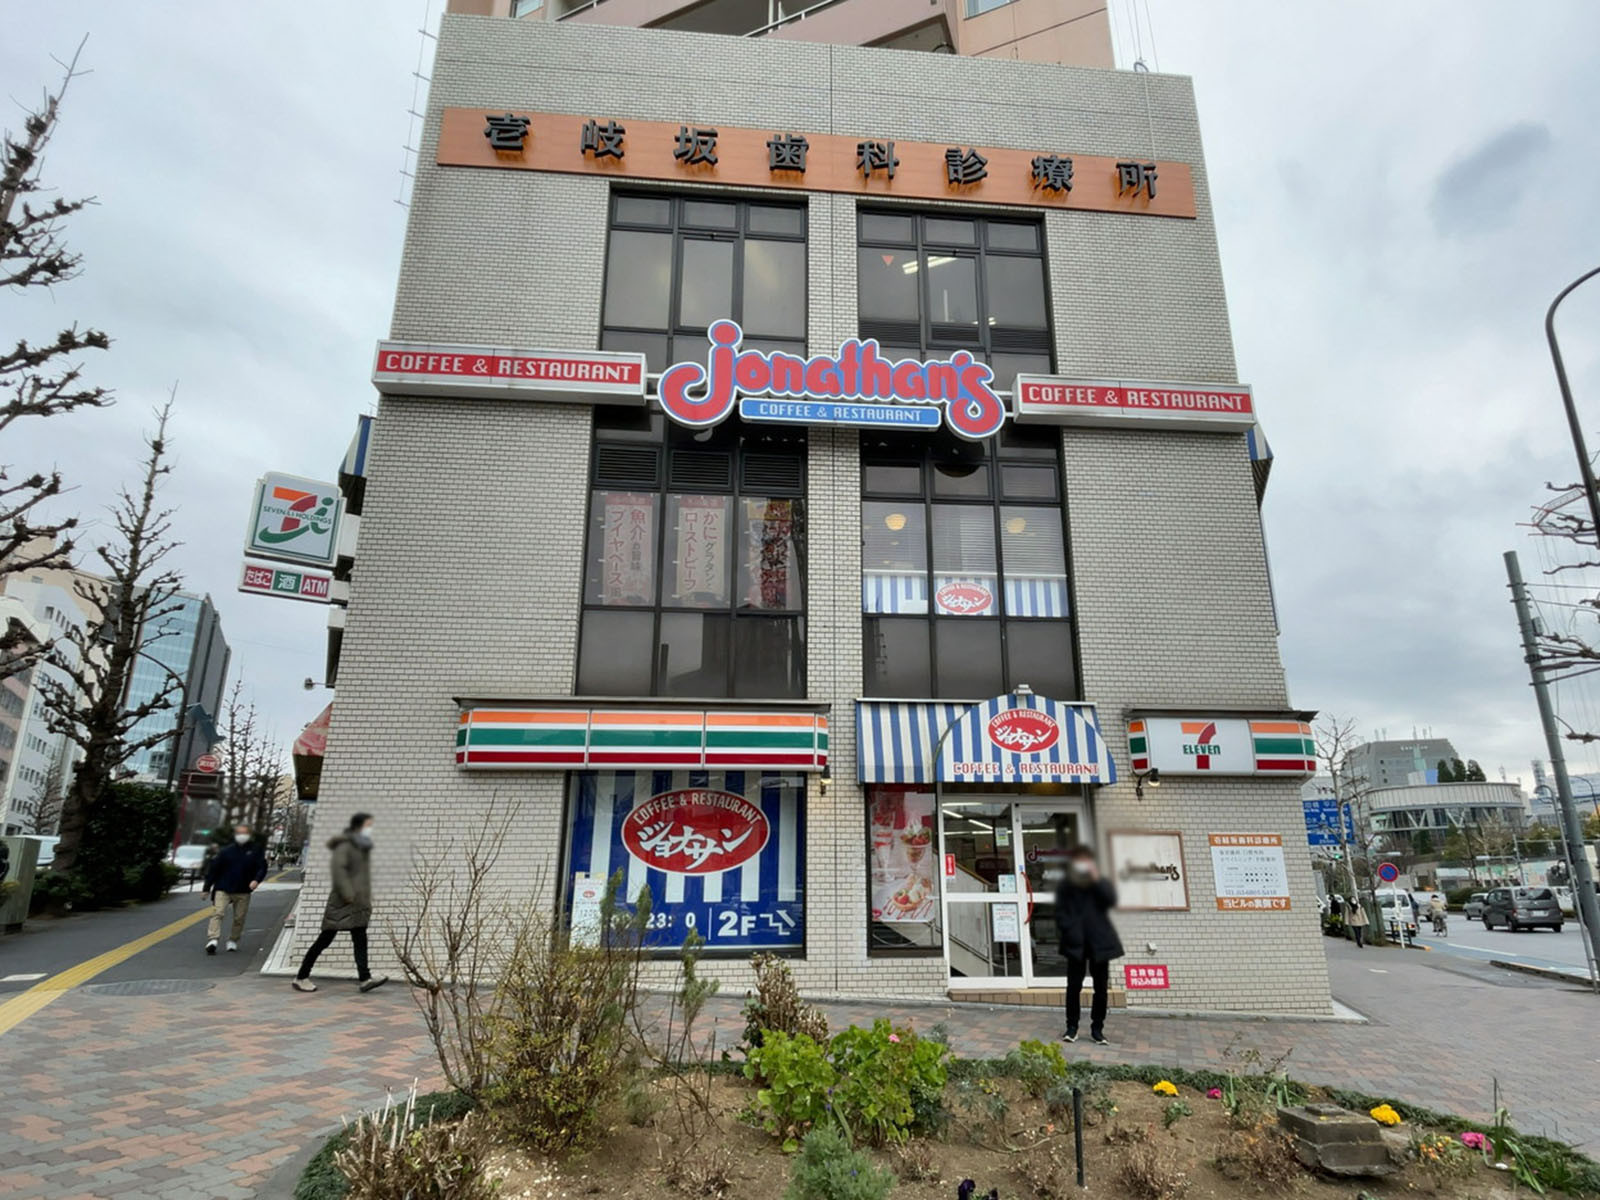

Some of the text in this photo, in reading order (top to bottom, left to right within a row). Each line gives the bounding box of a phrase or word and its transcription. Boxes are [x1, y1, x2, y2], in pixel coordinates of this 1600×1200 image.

[484, 113, 1158, 199] 壱岐坂歯科診療所
[386, 354, 632, 381] COFFEE & RESTAURANT
[1029, 386, 1243, 411] COFFEE & RESTAURANT
[759, 404, 921, 422] COFFEE & RESTAURANT
[245, 568, 272, 587] たばこ
[278, 573, 297, 590] 酒
[303, 578, 328, 595] ATM
[953, 763, 999, 775] COFFEE
[1020, 763, 1099, 775] RESTAURANT
[633, 796, 675, 825] COFFEE
[692, 792, 762, 824] RESTAURANT
[637, 821, 753, 870] ジョナサン
[718, 911, 756, 937] 2F
